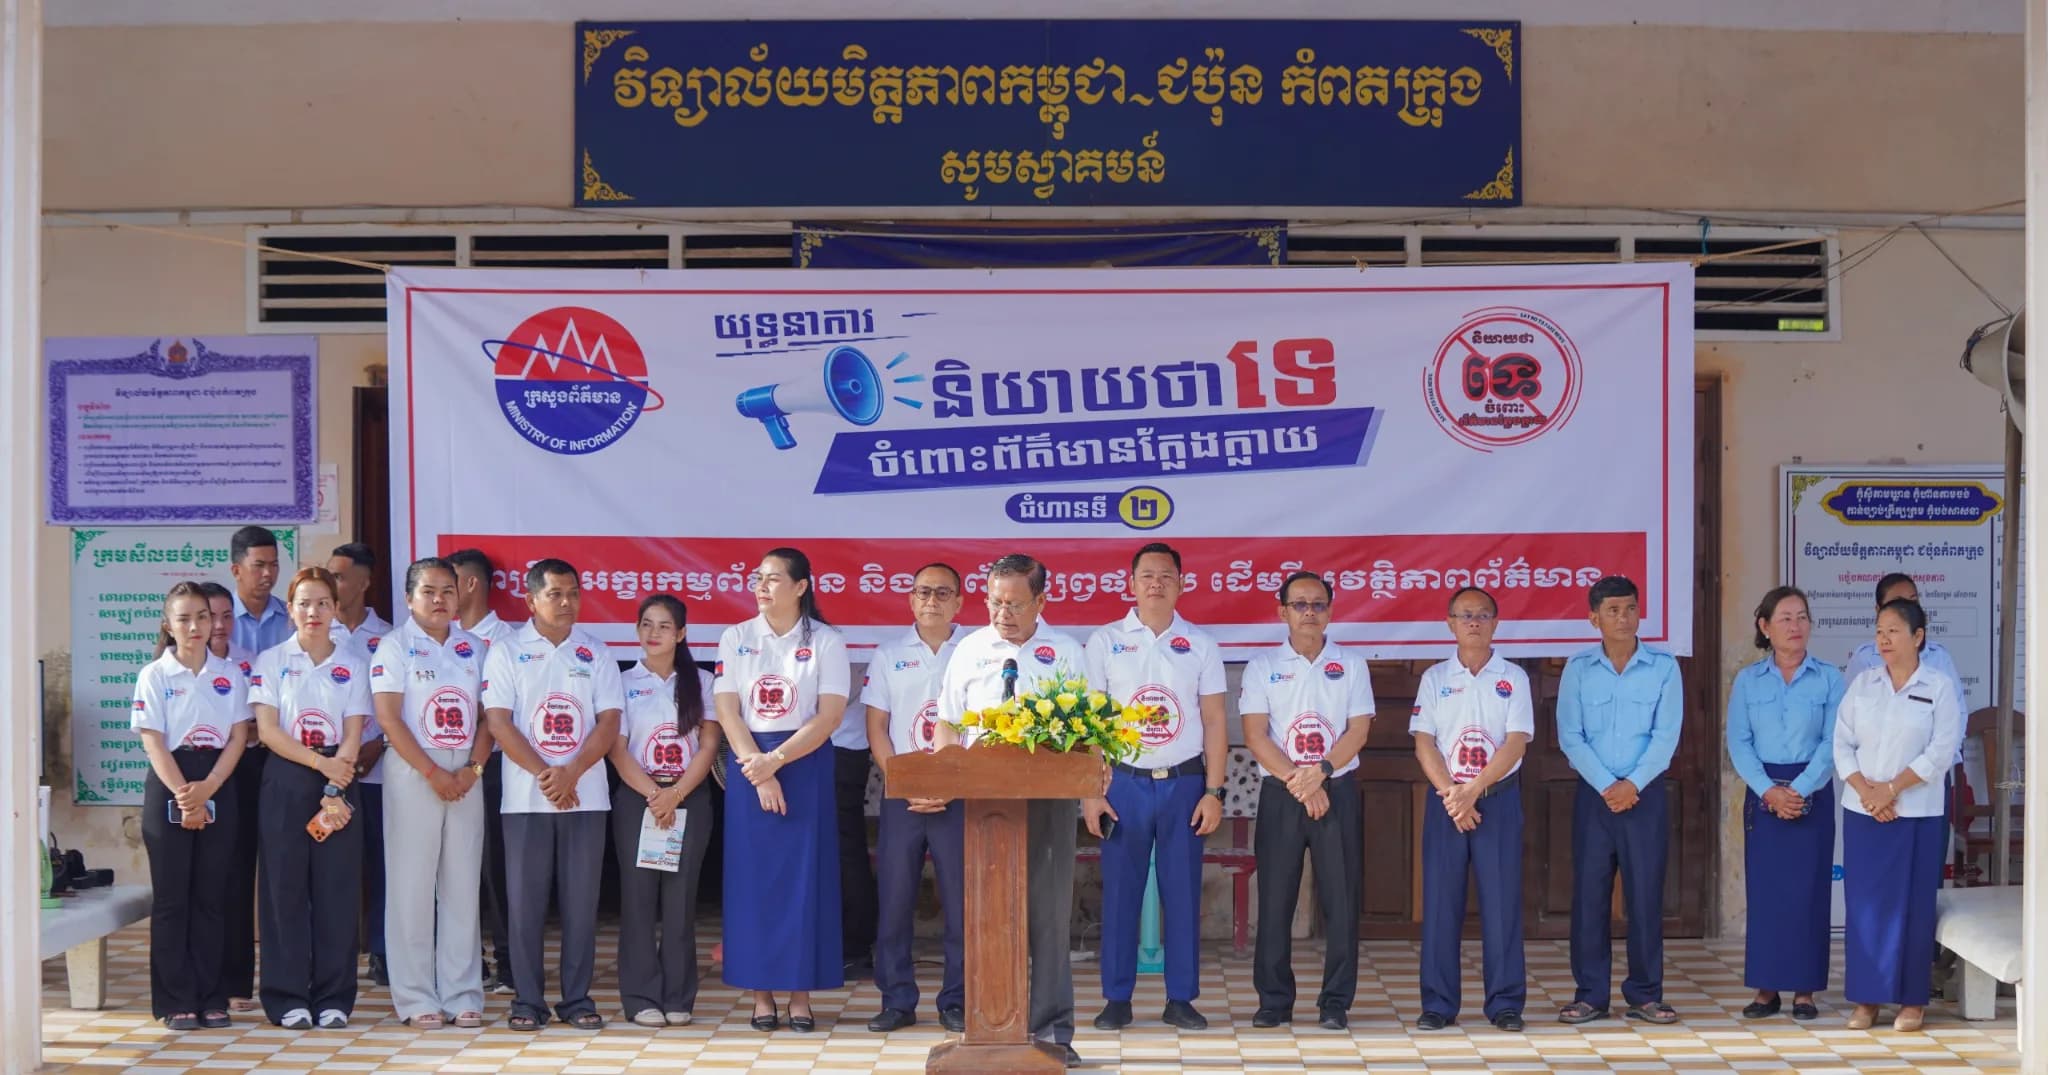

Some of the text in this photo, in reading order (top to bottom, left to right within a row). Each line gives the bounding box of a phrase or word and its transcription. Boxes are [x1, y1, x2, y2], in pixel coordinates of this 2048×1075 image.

[1281, 48, 1483, 128] កំពតក្រុង
[940, 131, 1165, 201] សូមស្វាគមន៍
[714, 308, 875, 349] យុទ្ធនាការ
[523, 384, 622, 409] ក្រសួងព័ត៌មាន
[1462, 352, 1542, 402] ទេ
[504, 400, 638, 451] MINISTRY OF INFORMATION
[868, 425, 1319, 478] ចំពោះព័ត៌មានក្លែងក្លាយ
[1018, 494, 1158, 521] ជំហានទី ២
